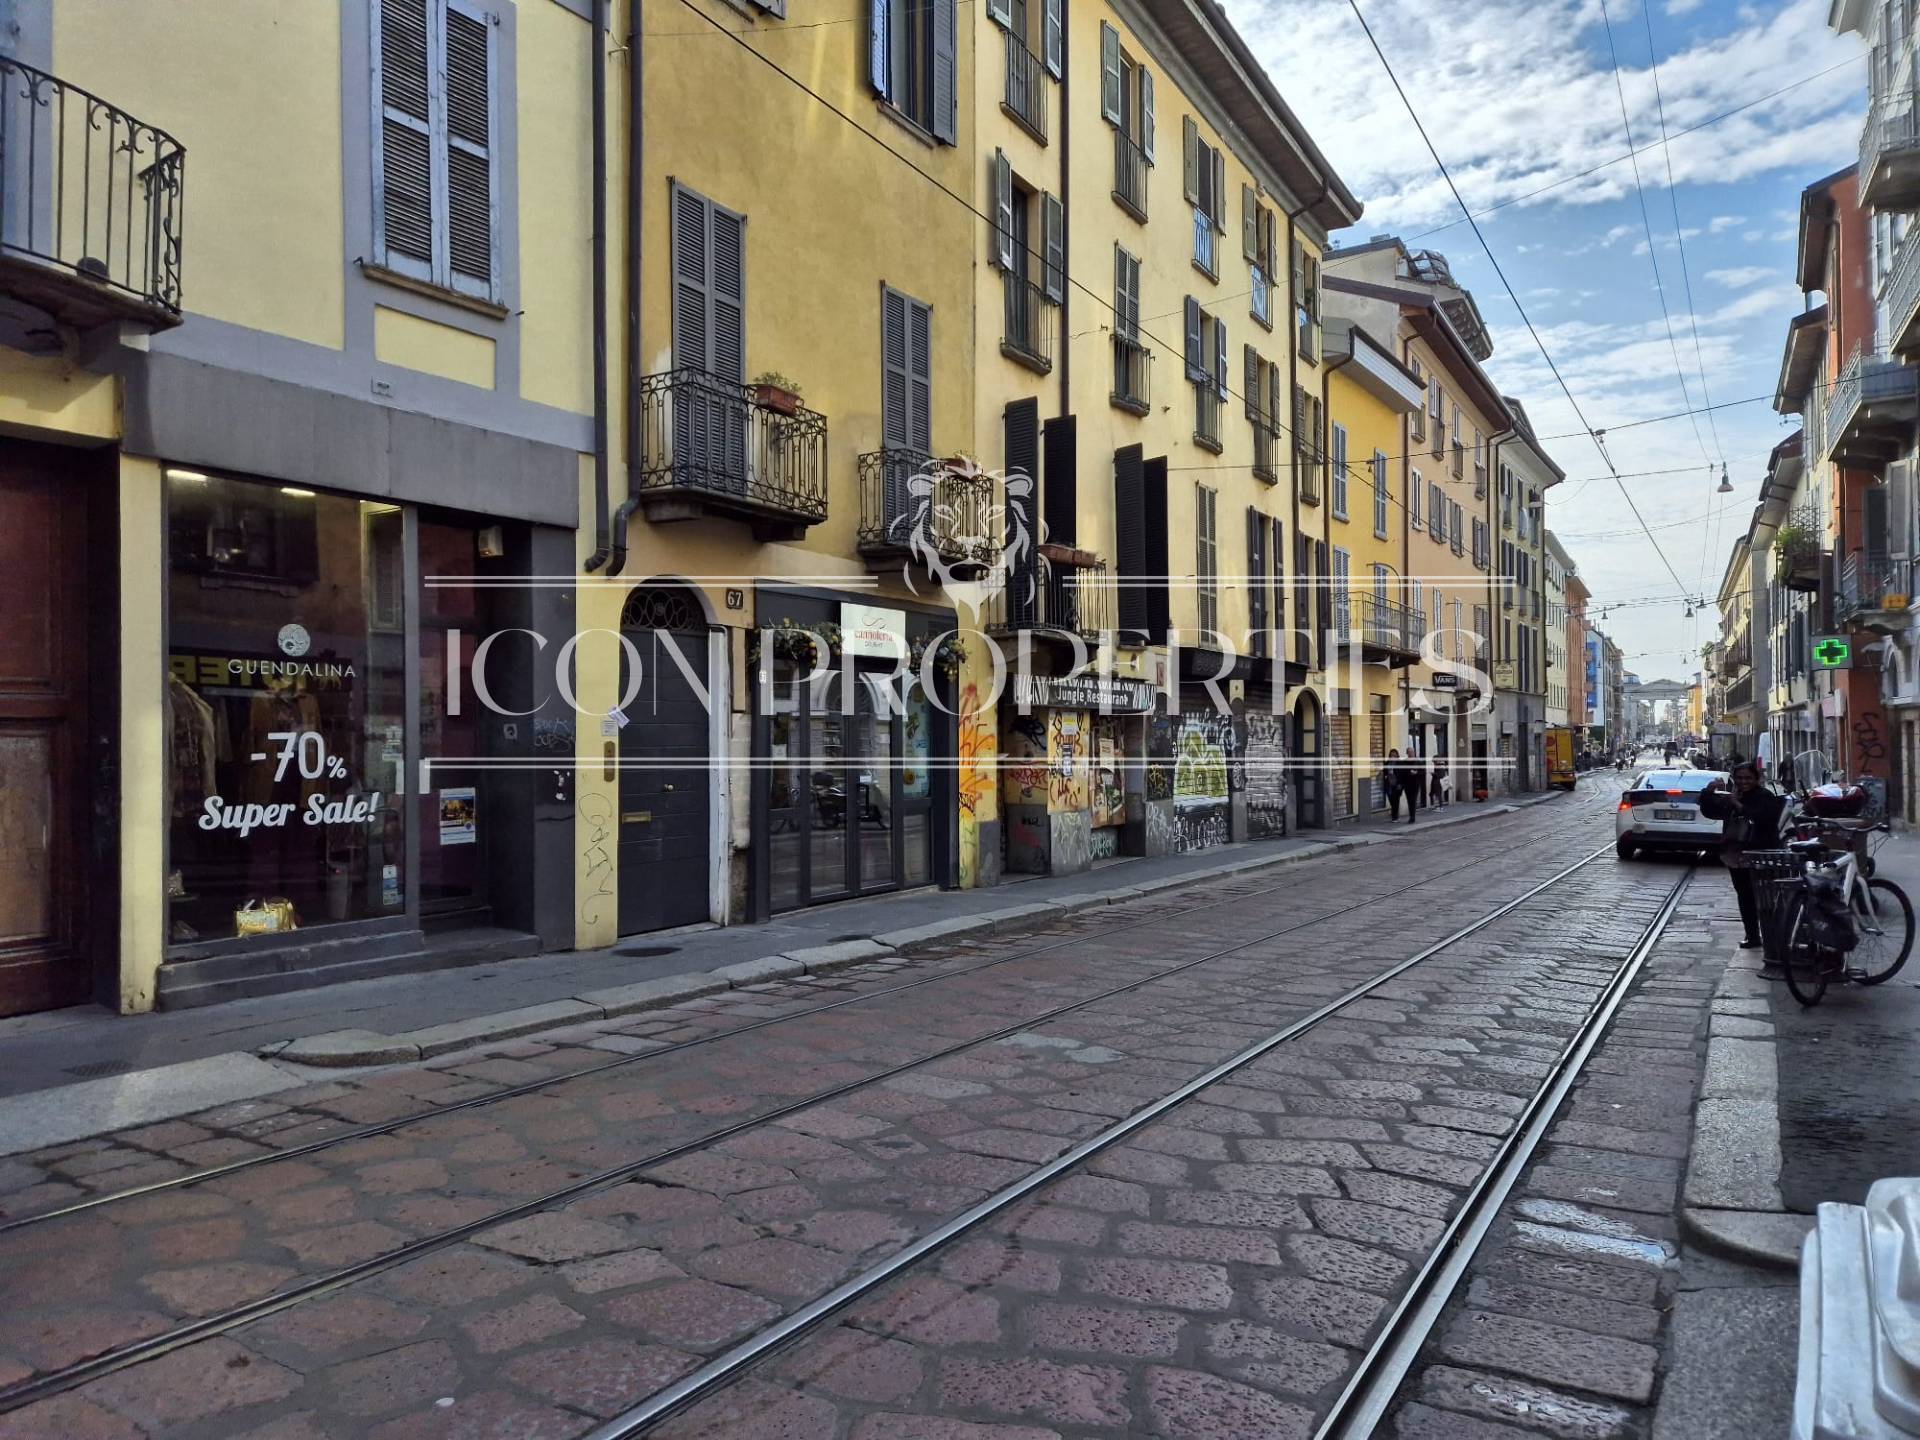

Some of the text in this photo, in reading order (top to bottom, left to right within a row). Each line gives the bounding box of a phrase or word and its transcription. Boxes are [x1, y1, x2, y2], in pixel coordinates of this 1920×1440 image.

[727, 591, 742, 607] 67
[228, 658, 356, 678] GUENDALINA
[1057, 689, 1129, 706] Jungle Restaurant
[251, 731, 348, 783] -70%
[199, 791, 380, 838] Super Sale!
